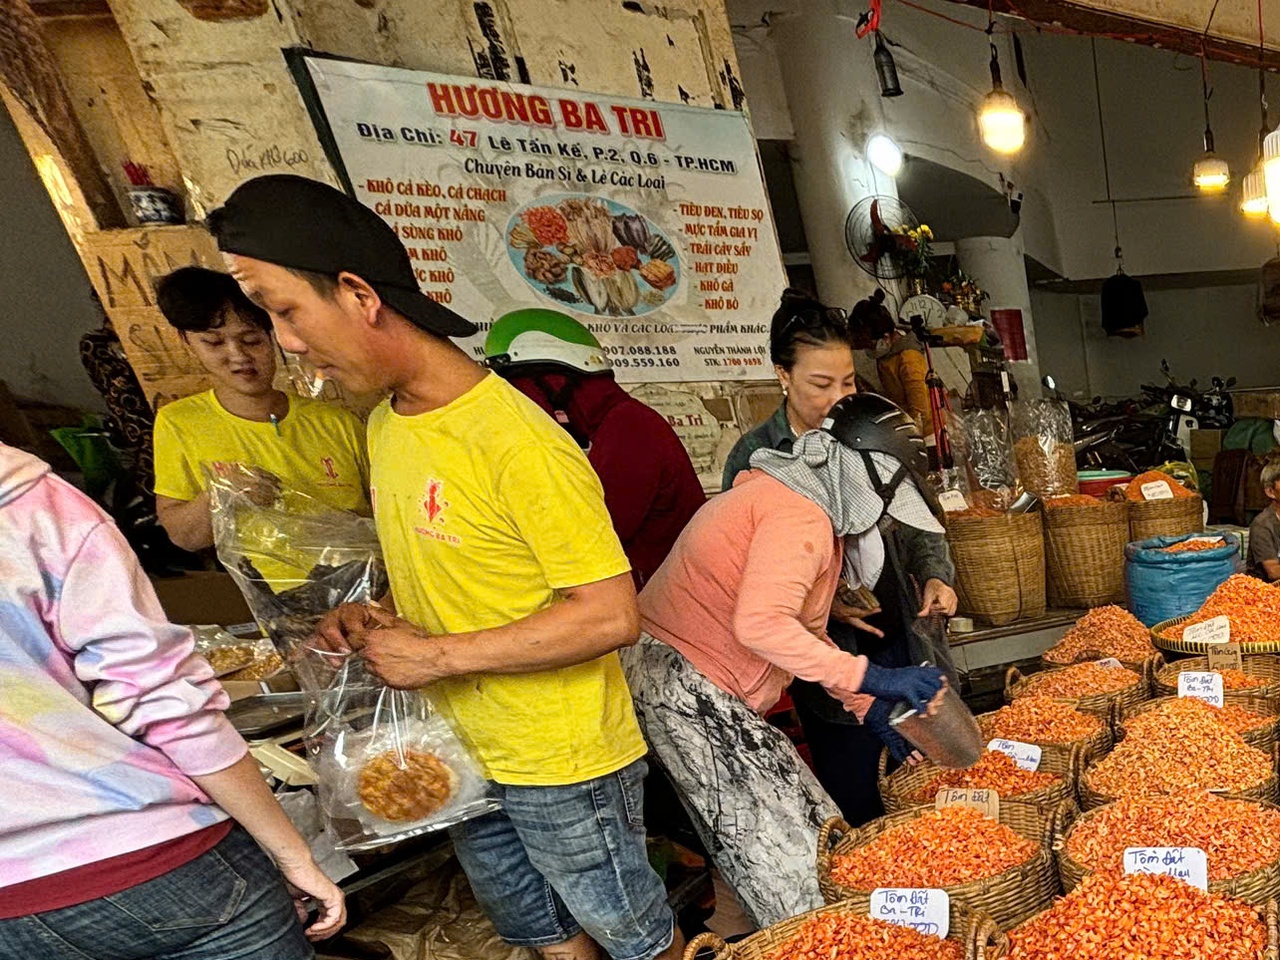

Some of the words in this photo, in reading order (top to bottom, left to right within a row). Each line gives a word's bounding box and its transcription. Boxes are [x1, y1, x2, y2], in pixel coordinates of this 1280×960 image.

[427, 82, 553, 126] HƯƠNG
[558, 99, 609, 134] BA
[611, 105, 665, 139] TRI
[356, 122, 394, 142] Địa
[401, 126, 444, 144] Chỉ:
[450, 129, 478, 147] 47
[488, 136, 511, 151] Lê
[517, 137, 552, 154] Tấn
[558, 142, 588, 160] Kế,
[630, 151, 658, 167] Q.6
[674, 155, 736, 173] TP.HCM
[464, 157, 521, 179] Chuyên
[525, 162, 555, 180] Bán
[576, 171, 588, 182] &
[611, 171, 634, 187] Các
[638, 175, 665, 193] Loại
[367, 178, 393, 194] KHÔ
[397, 179, 413, 196] CÁ
[447, 183, 464, 200] CÁ
[466, 187, 506, 204] CHẠCH
[375, 200, 392, 216] CÁ
[438, 226, 463, 241] KHÔ
[730, 226, 745, 238] GIA
[747, 227, 758, 242] VỊ
[421, 246, 447, 262] KHÔ
[690, 241, 712, 255] TRÁI
[429, 269, 455, 283] KHÔ
[695, 262, 714, 276] HẠT
[700, 278, 720, 291] KHÔ
[705, 296, 724, 310] KHÔ
[878, 890, 908, 904] Tôm
